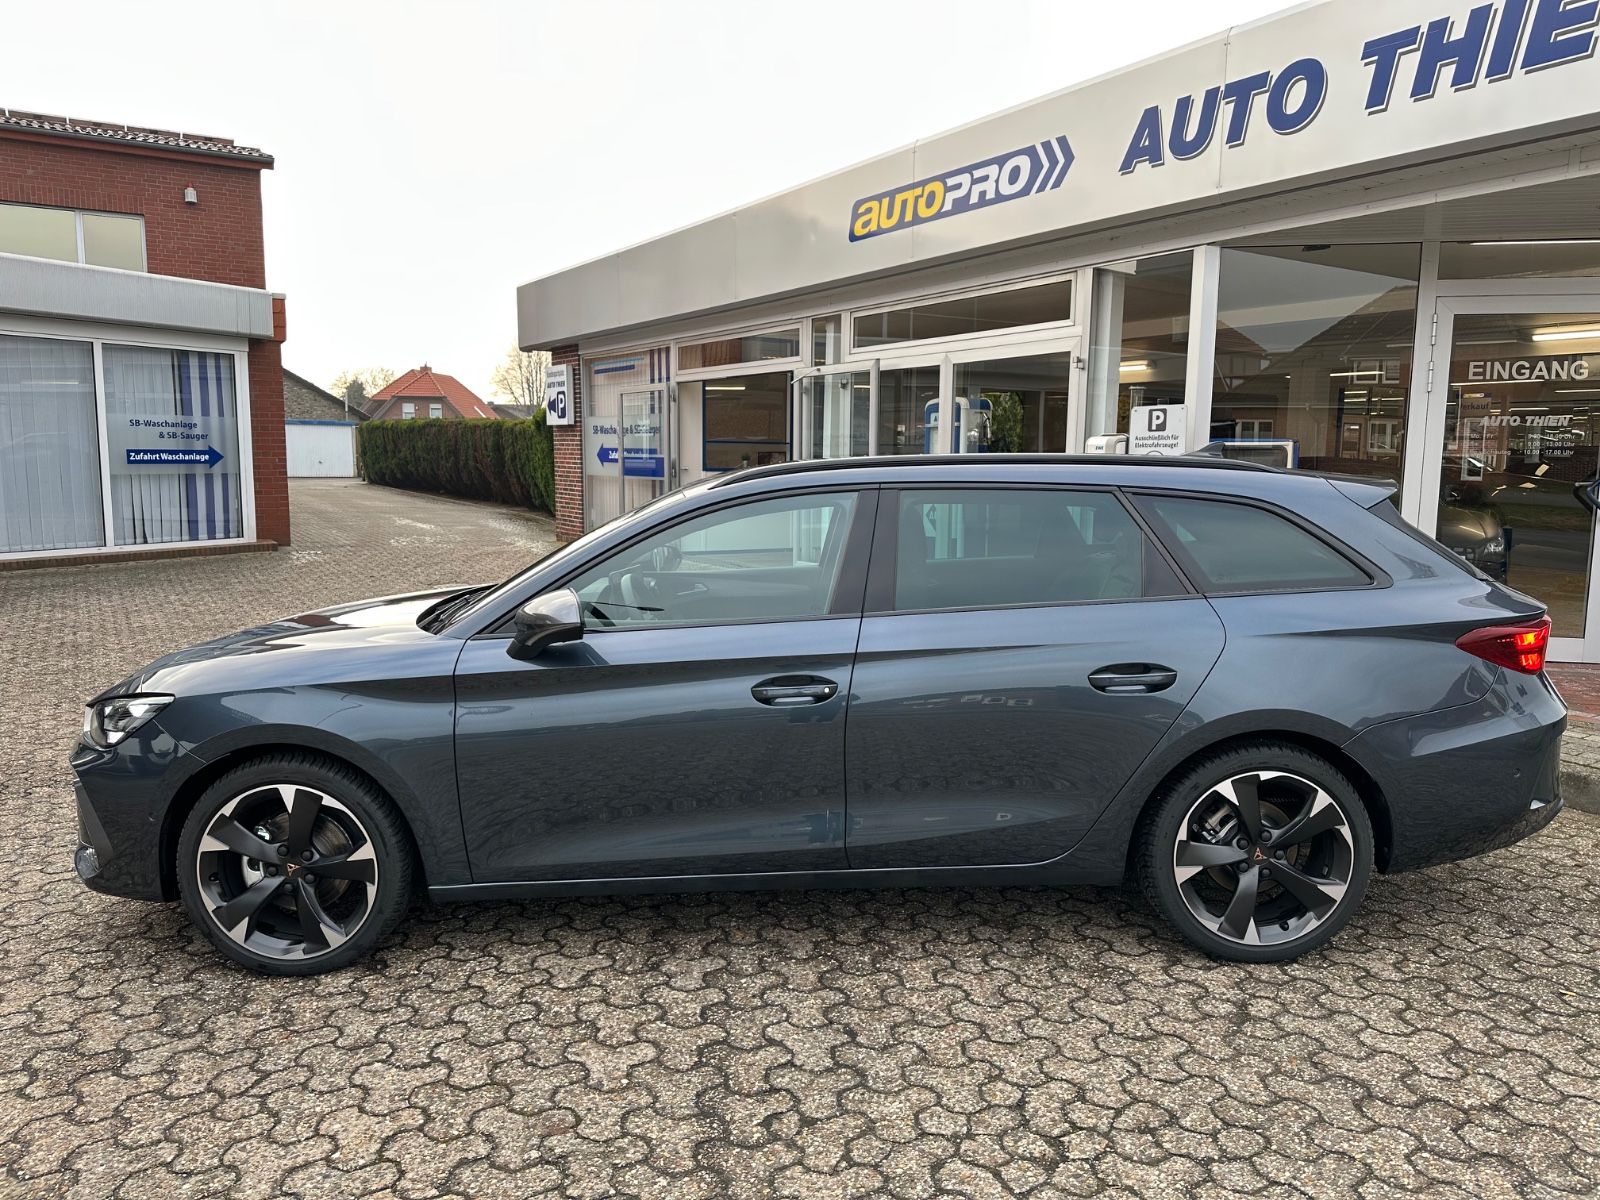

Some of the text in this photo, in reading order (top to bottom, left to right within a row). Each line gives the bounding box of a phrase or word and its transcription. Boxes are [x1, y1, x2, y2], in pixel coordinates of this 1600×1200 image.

[1118, 57, 1328, 175] AUTO
[1468, 360, 1589, 380] EINGANG
[129, 419, 198, 430] SB-Waschanlage
[1151, 410, 1165, 430] P
[1480, 416, 1570, 426] AUTO THIEN
[158, 431, 209, 441] & SB-Sauger
[160, 453, 209, 461] Waschanlage
